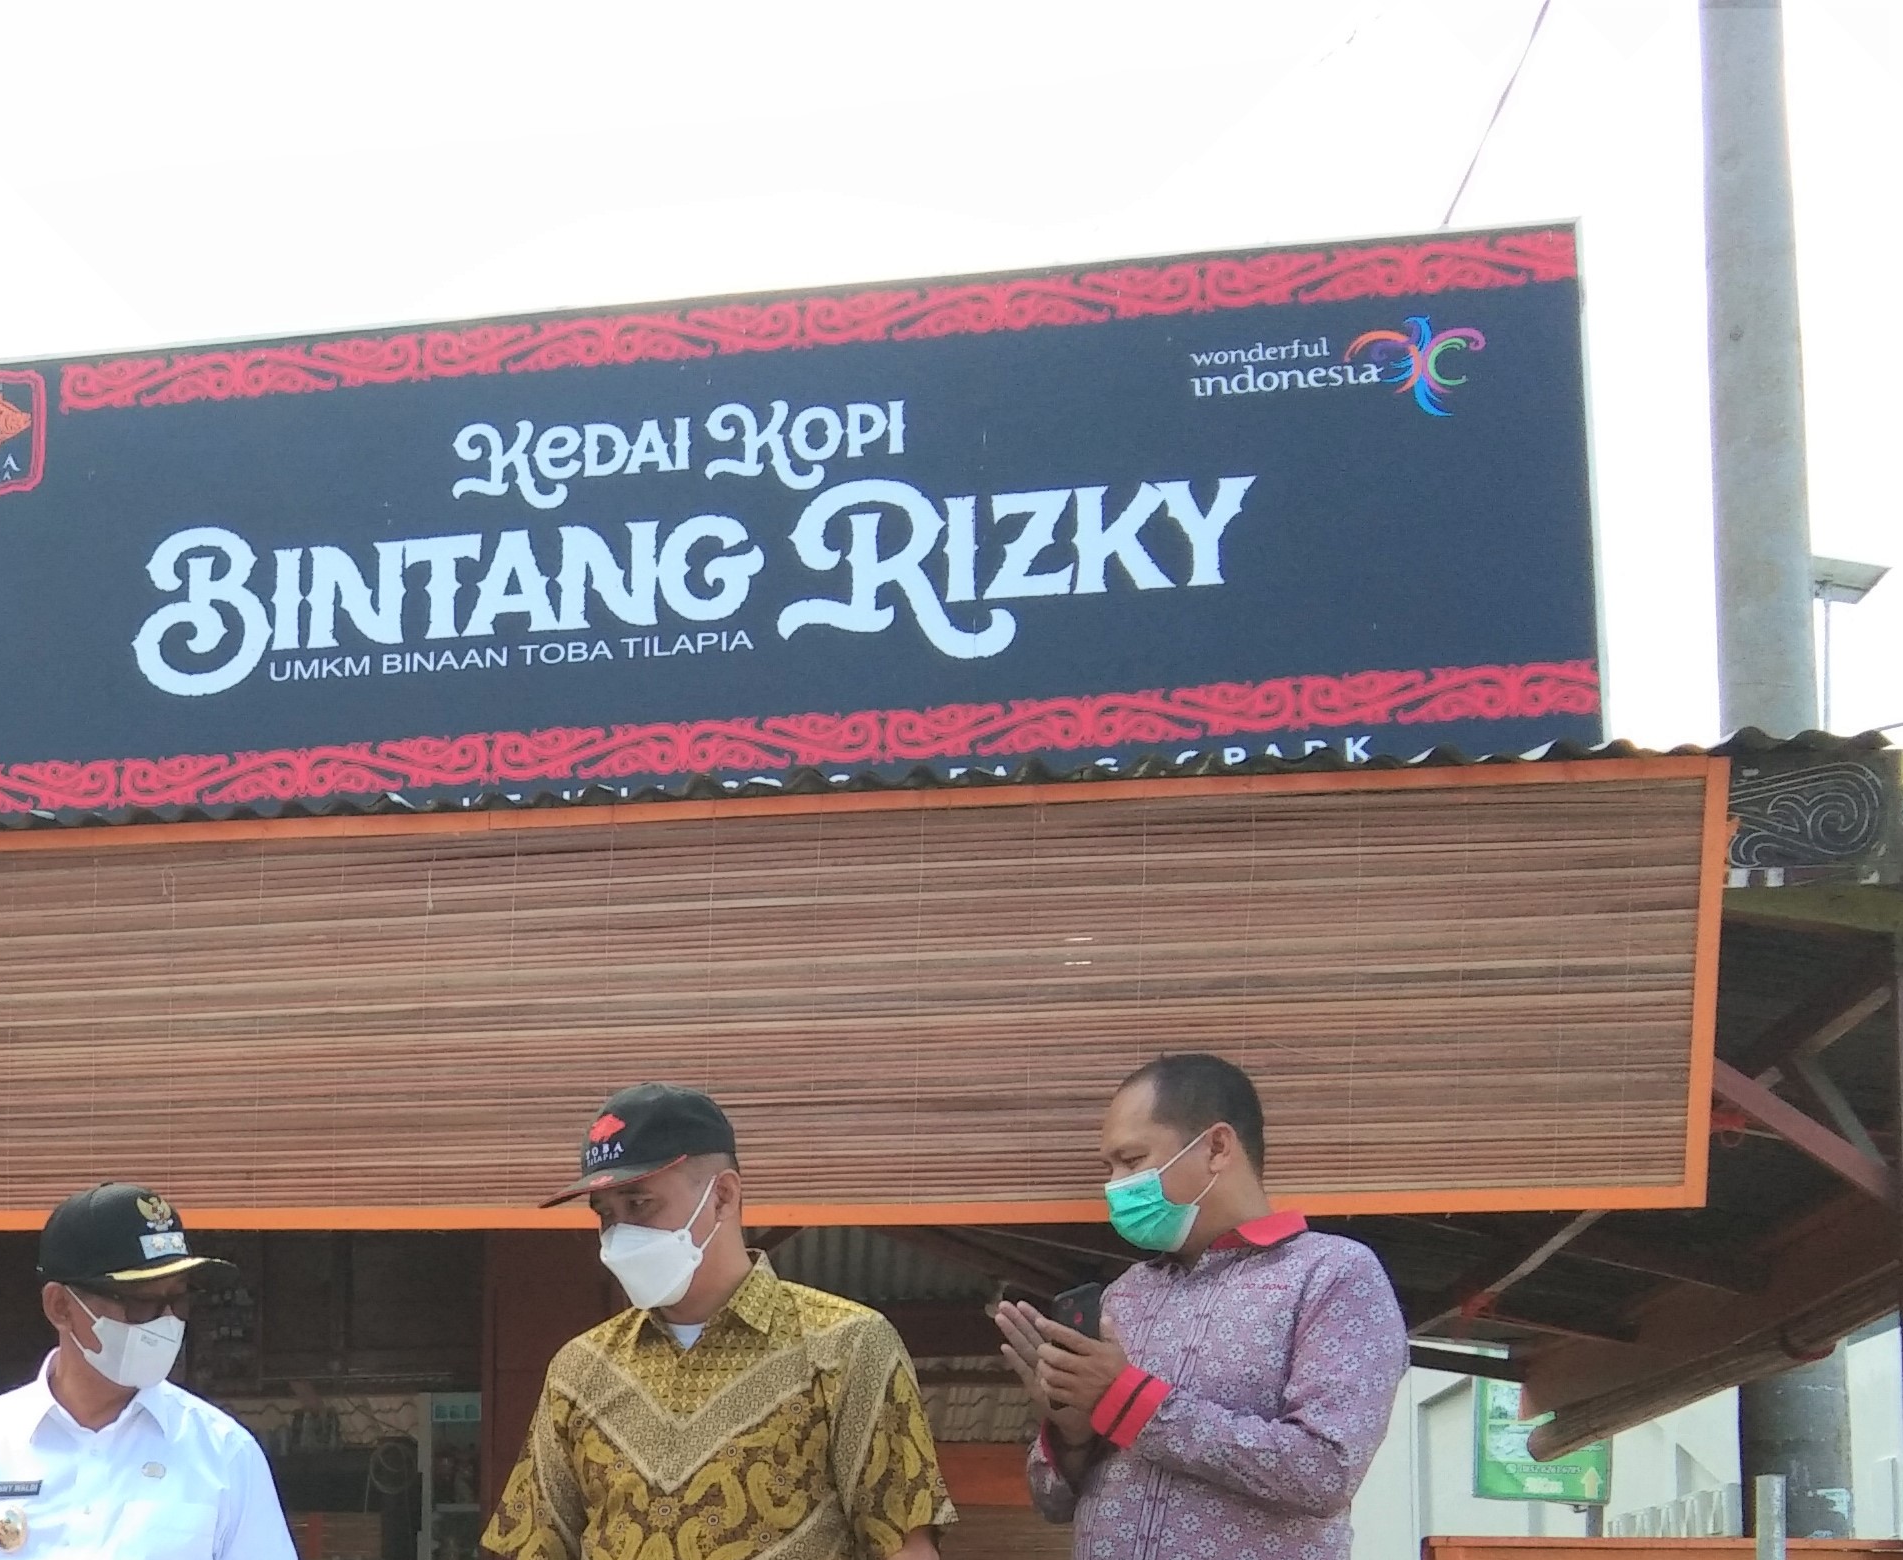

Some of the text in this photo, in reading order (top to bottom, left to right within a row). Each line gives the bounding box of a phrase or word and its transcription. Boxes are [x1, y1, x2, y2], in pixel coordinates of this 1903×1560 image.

[1189, 337, 1330, 367] wonderful
[1189, 363, 1384, 397] indonesia
[704, 400, 907, 491] KOPI
[131, 475, 1257, 697] BINTANG RIZKY
[269, 629, 755, 683] UMKM BINAAN TOBA TILAPIA
[585, 1141, 625, 1161] TOBA
